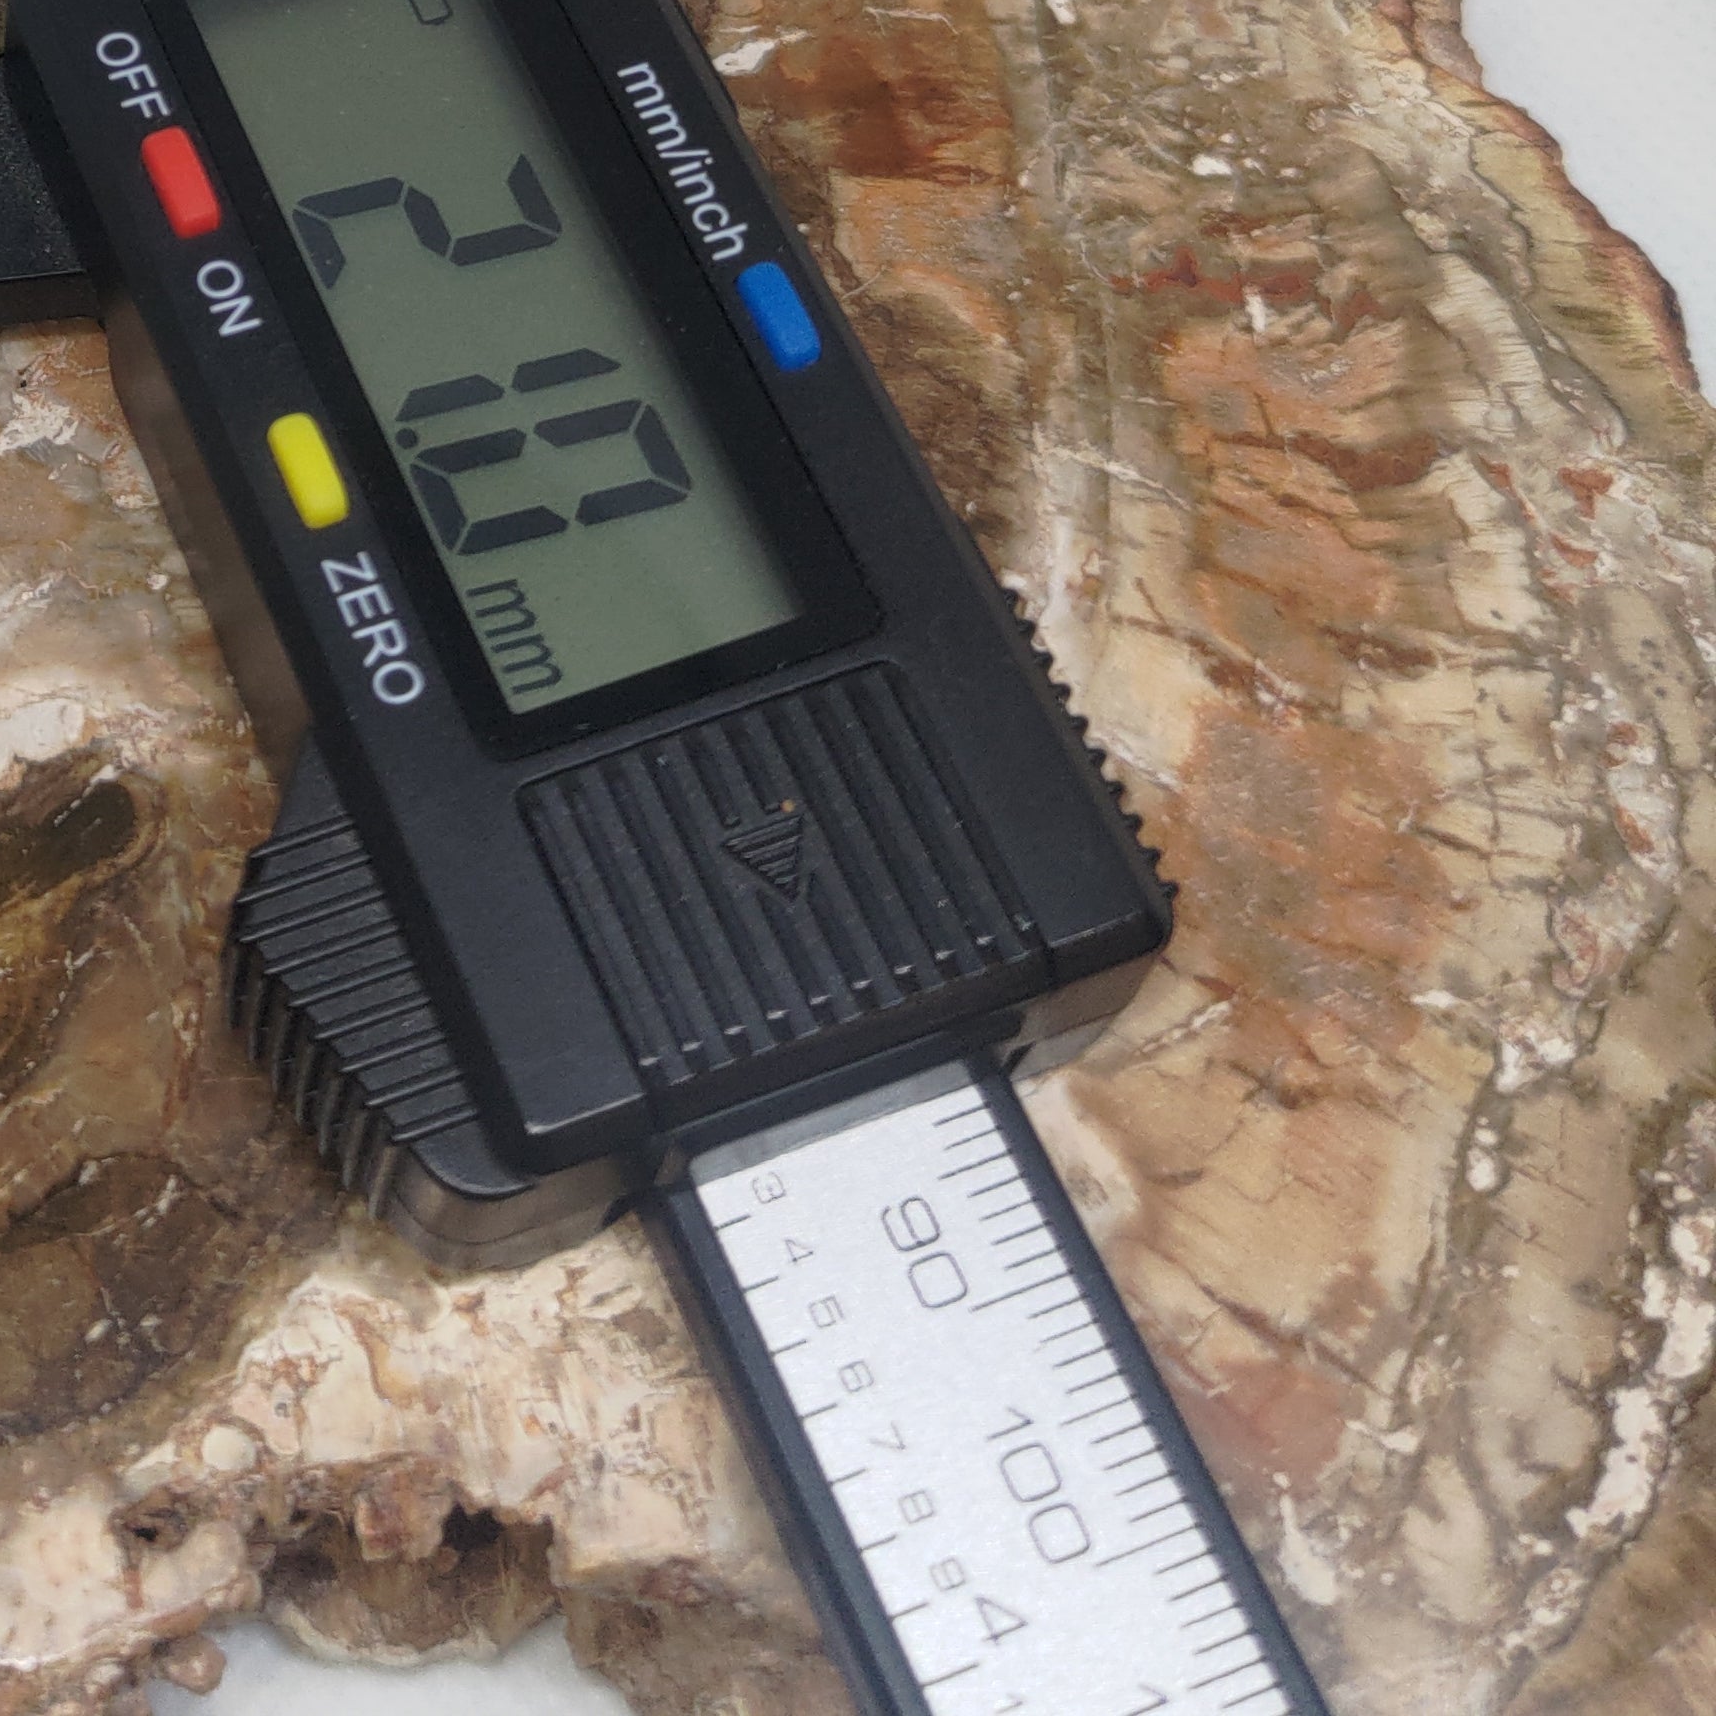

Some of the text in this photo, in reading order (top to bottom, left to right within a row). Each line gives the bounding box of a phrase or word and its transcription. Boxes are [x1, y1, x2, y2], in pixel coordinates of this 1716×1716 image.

[95, 30, 172, 118] OFF
[615, 60, 747, 263] mm/inch
[195, 258, 263, 337] ON
[320, 550, 426, 706] ZERO
[466, 577, 563, 696] mm
[784, 1237, 814, 1266] 4
[974, 1595, 1029, 1646] 4
[880, 1195, 969, 1309] 90
[986, 1406, 1092, 1565] 100
